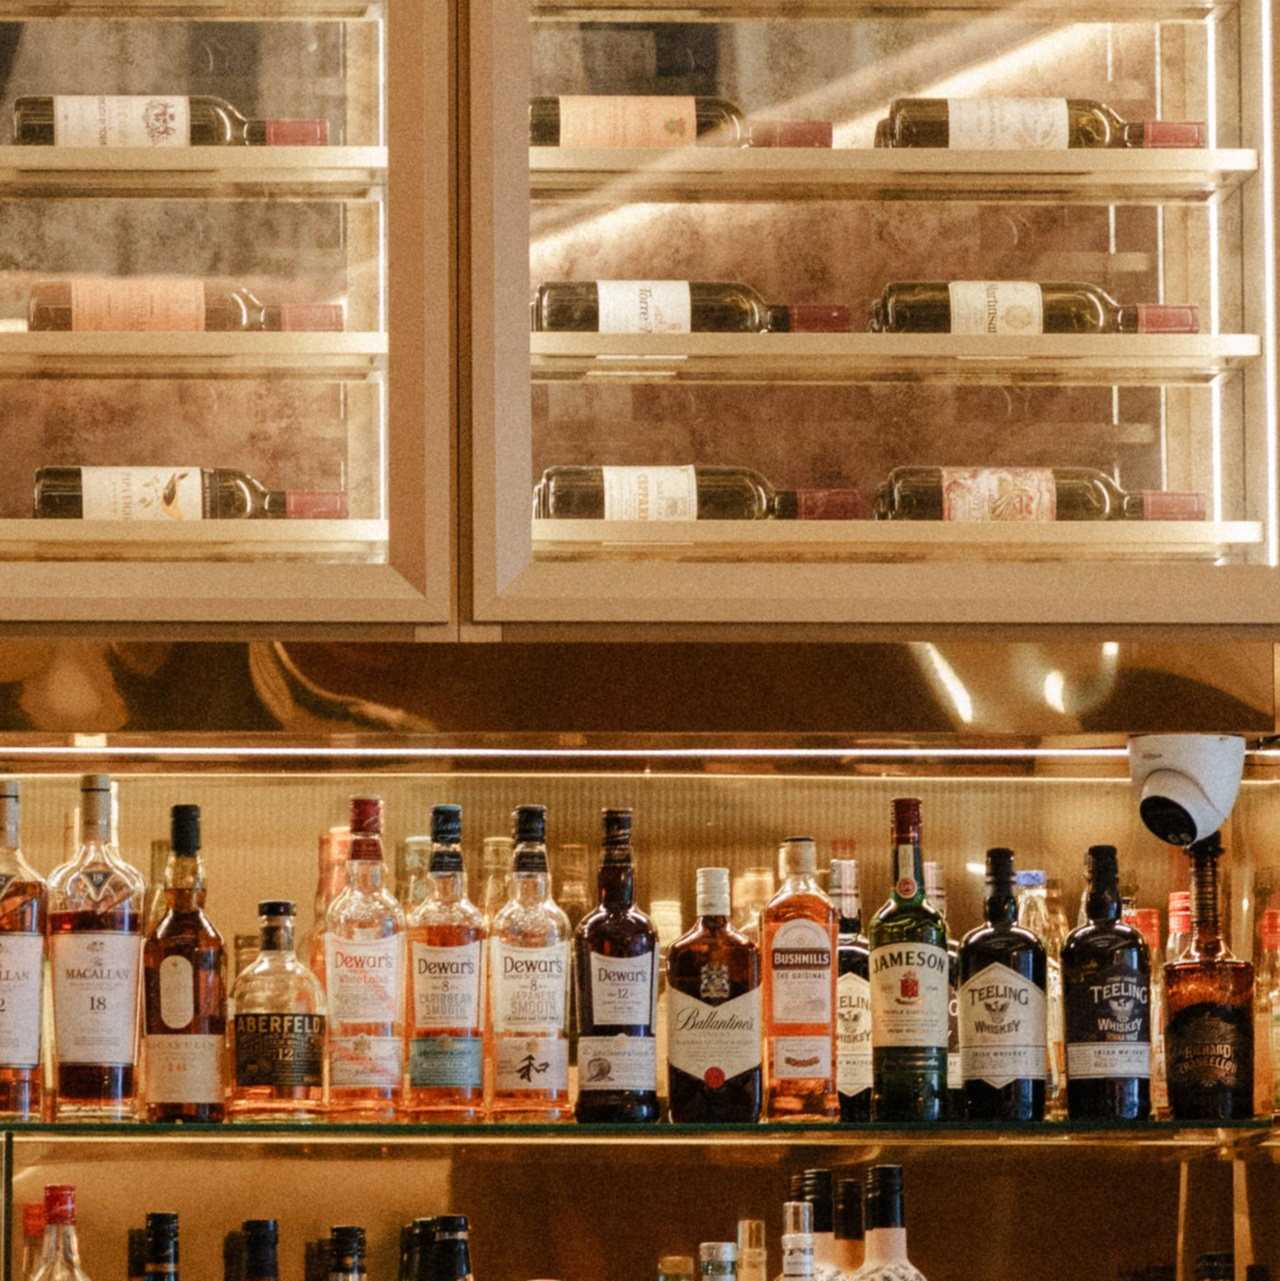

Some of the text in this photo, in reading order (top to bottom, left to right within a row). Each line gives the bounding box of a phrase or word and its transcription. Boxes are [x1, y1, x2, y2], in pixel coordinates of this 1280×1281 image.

[334, 951, 393, 969] Dewar's
[503, 956, 563, 973] Dewar's
[773, 952, 830, 965] BUSHMILLS
[872, 950, 946, 974] JAMESON
[418, 958, 475, 975] Dewar's
[66, 969, 129, 980] MACALLAN
[598, 967, 647, 983] Dewar's
[529, 980, 538, 990] 8
[618, 989, 629, 999] 12
[969, 985, 1029, 1006] TEELING
[1090, 983, 1148, 1004] TEELING
[89, 996, 107, 1011] 18
[425, 1004, 466, 1016] SMOOTH
[511, 1002, 556, 1014] SMOOTH
[237, 1016, 320, 1034] ABERFELD
[673, 1007, 755, 1032] Ballantine's
[1097, 1017, 1142, 1032] WHISKEY
[974, 1020, 1020, 1035] WHISKEY
[277, 1047, 294, 1061] 12
